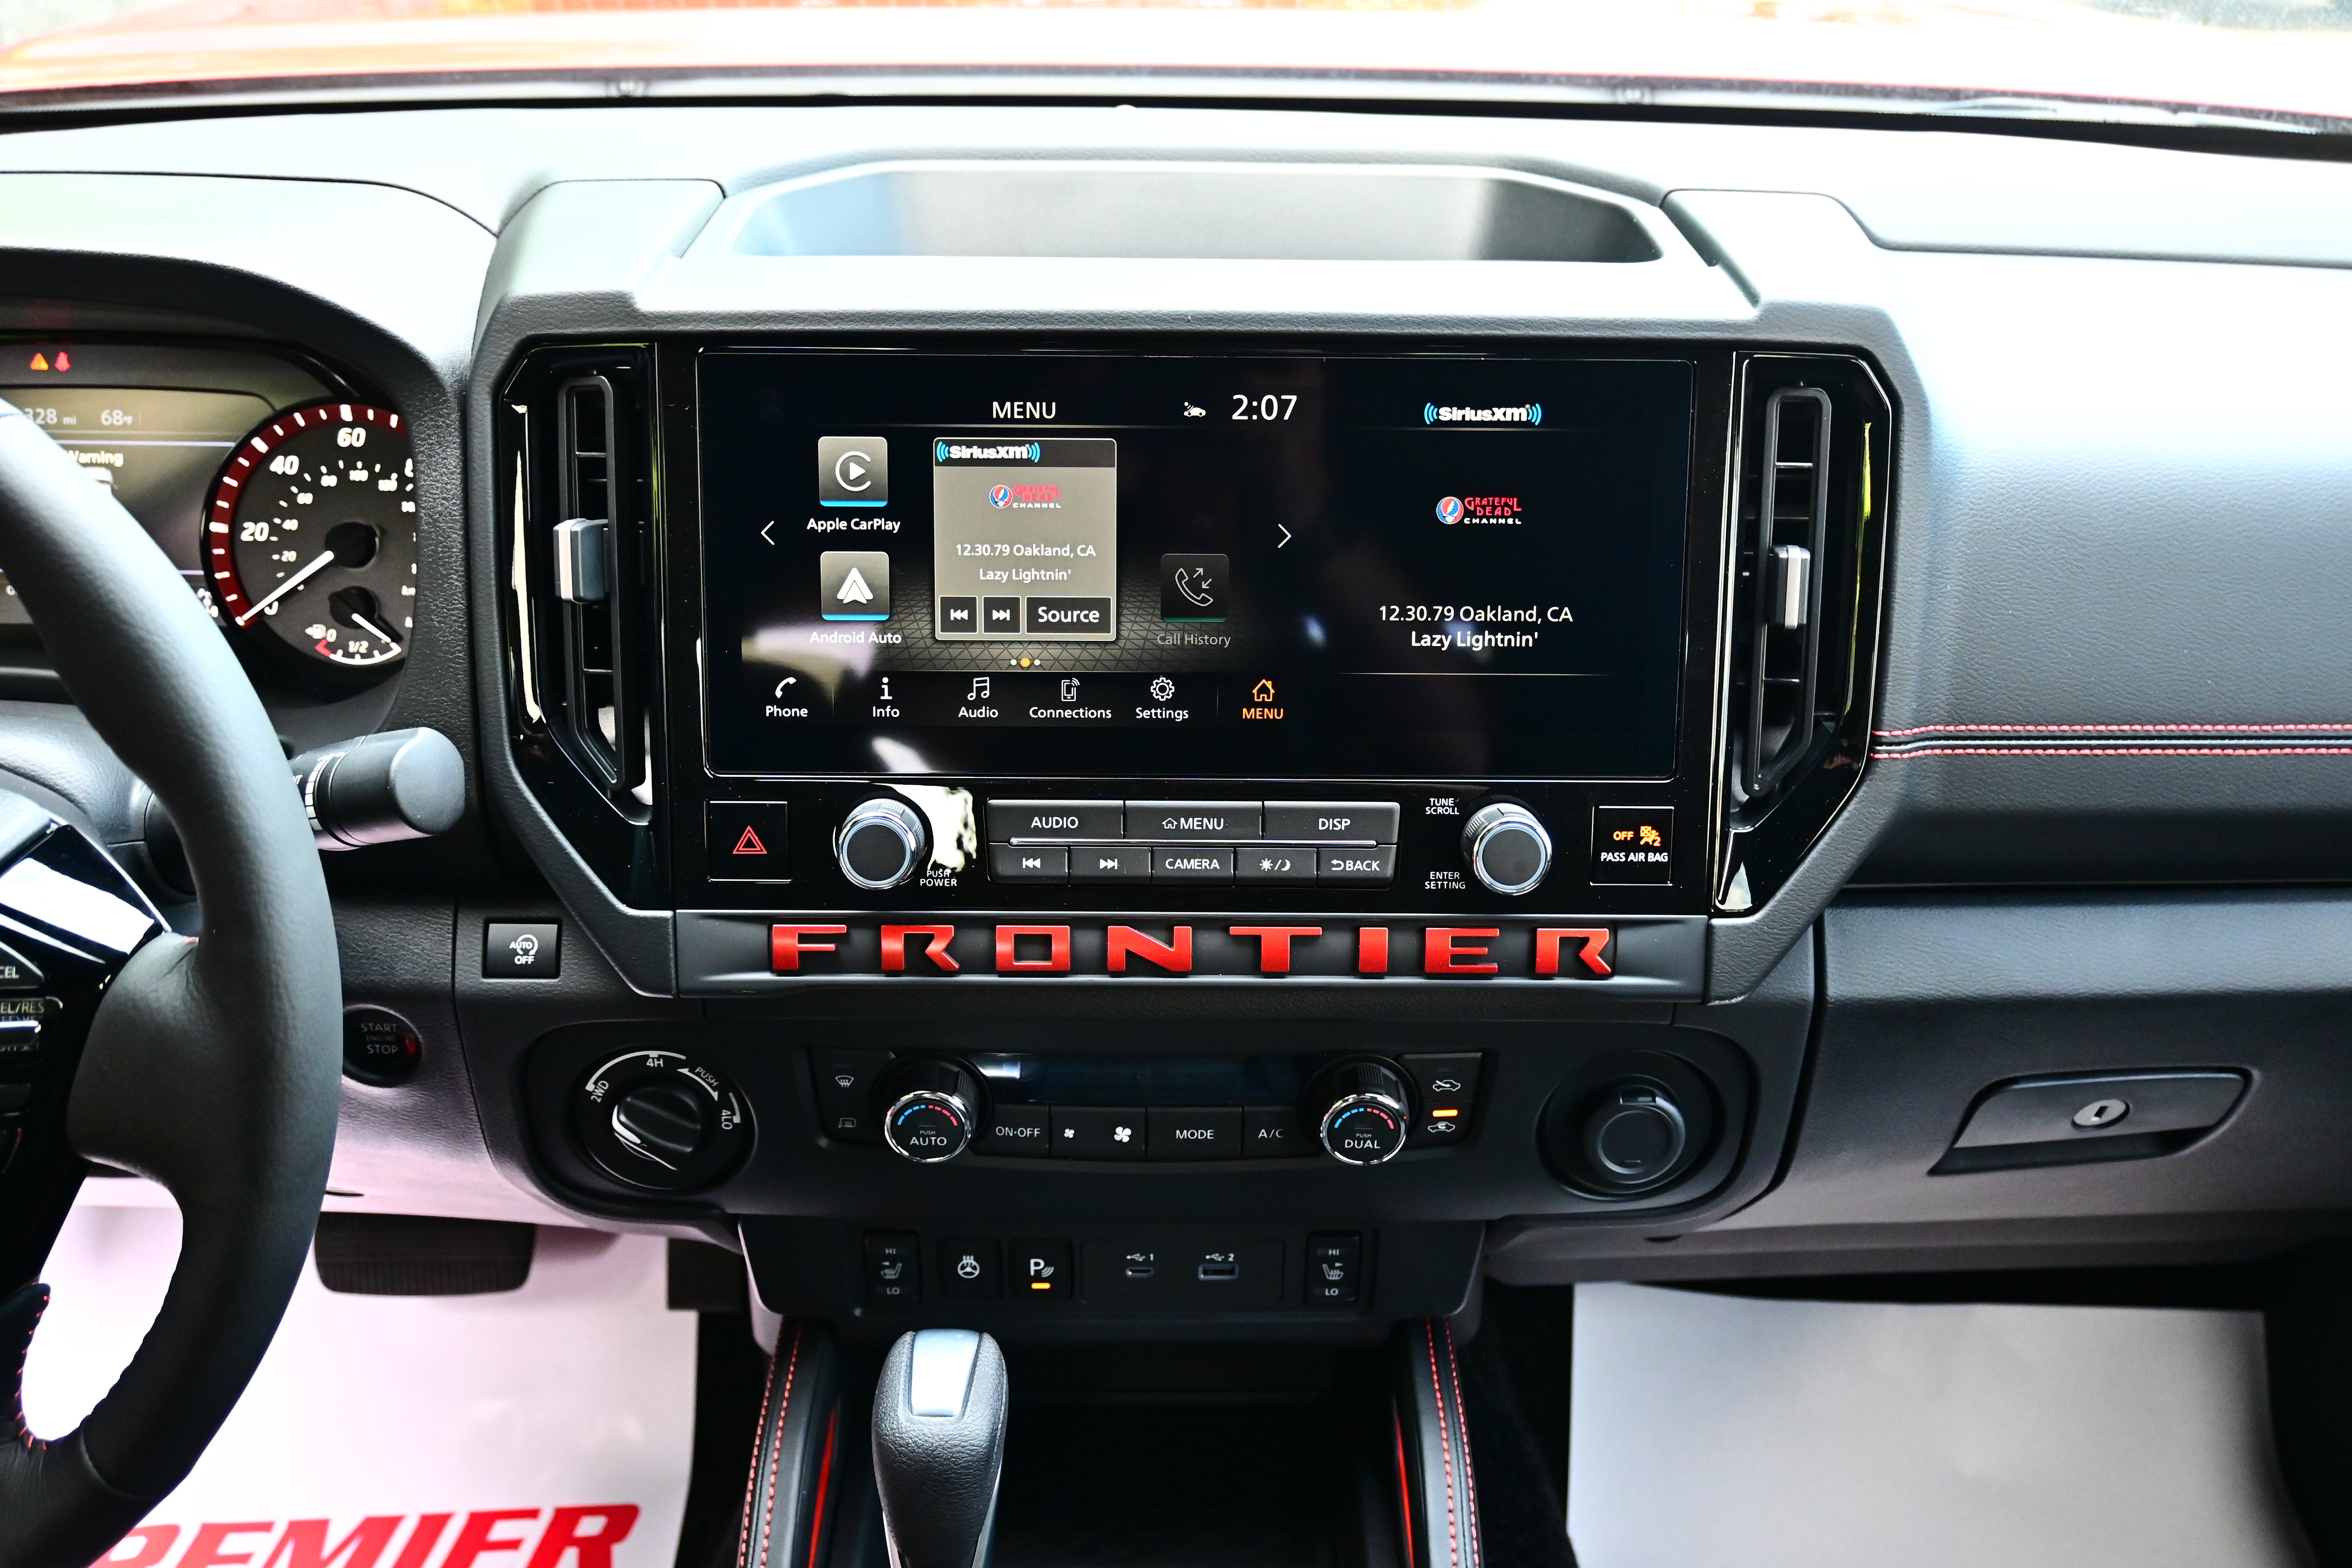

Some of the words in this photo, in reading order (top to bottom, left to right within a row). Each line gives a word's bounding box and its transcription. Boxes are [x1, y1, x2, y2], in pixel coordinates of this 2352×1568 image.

[993, 401, 1056, 419] MENU
[1232, 394, 1297, 420] 2:07
[337, 427, 366, 447] 60
[270, 455, 299, 475] 40
[1464, 497, 1522, 511] GRATEFUL
[1476, 507, 1511, 516] DEAD
[806, 517, 847, 533] Apple
[850, 517, 901, 534] CarPlay
[240, 522, 269, 542] 20
[956, 544, 1010, 556] 12.30.79
[1013, 544, 1074, 558] Oakland,
[1077, 544, 1096, 557] CA
[980, 568, 1009, 583] Lazy
[1012, 568, 1071, 583] Lightnin'
[1038, 606, 1100, 623] Source
[1380, 605, 1454, 621] 12.30.79
[1459, 605, 1542, 624] Oakland,
[1547, 607, 1573, 622] CA
[809, 631, 865, 645] Android
[868, 631, 902, 644] Auto
[1157, 633, 1182, 646] Call
[1185, 632, 1232, 649] History
[1411, 629, 1452, 651] Lazy
[1455, 629, 1539, 651] Lightnin'
[766, 705, 808, 717] Phone
[873, 705, 900, 717] Info
[958, 706, 999, 718] Audio
[1029, 707, 1112, 719] Connections
[1136, 707, 1189, 721] Settings
[1242, 708, 1283, 719] MENU
[1429, 798, 1454, 806] TUNE
[1425, 806, 1460, 815] SCROLL
[1031, 817, 1078, 829] AUDIO
[1180, 817, 1224, 830] MENU
[1319, 818, 1350, 830] DISP
[1613, 830, 1634, 841] OFF
[1600, 852, 1626, 862] PASS
[1628, 852, 1645, 862] AIR
[1647, 852, 1668, 862] BAG
[1165, 858, 1220, 869] CAMERA
[1346, 860, 1380, 871] BACK
[926, 869, 950, 878] PUSH
[1430, 871, 1460, 879] ENTER
[920, 878, 957, 887] POWER
[1424, 881, 1465, 889] SETTING
[509, 941, 534, 950] AUTO
[770, 924, 1614, 975] FRONTIER
[514, 954, 535, 964] OFF
[360, 1022, 398, 1033] START
[366, 1044, 399, 1055] STOP
[646, 1058, 663, 1067] 4H
[694, 1067, 719, 1088] PUSH
[590, 1079, 610, 1103] 2WD
[721, 1108, 733, 1130] 4LO
[1176, 1130, 1214, 1139] MODE
[1258, 1129, 1285, 1139] A/C
[909, 1137, 947, 1146] AUTO
[1345, 1139, 1380, 1149] DUAL
[1228, 1253, 1234, 1261] 2
[1325, 1288, 1339, 1296] LO
